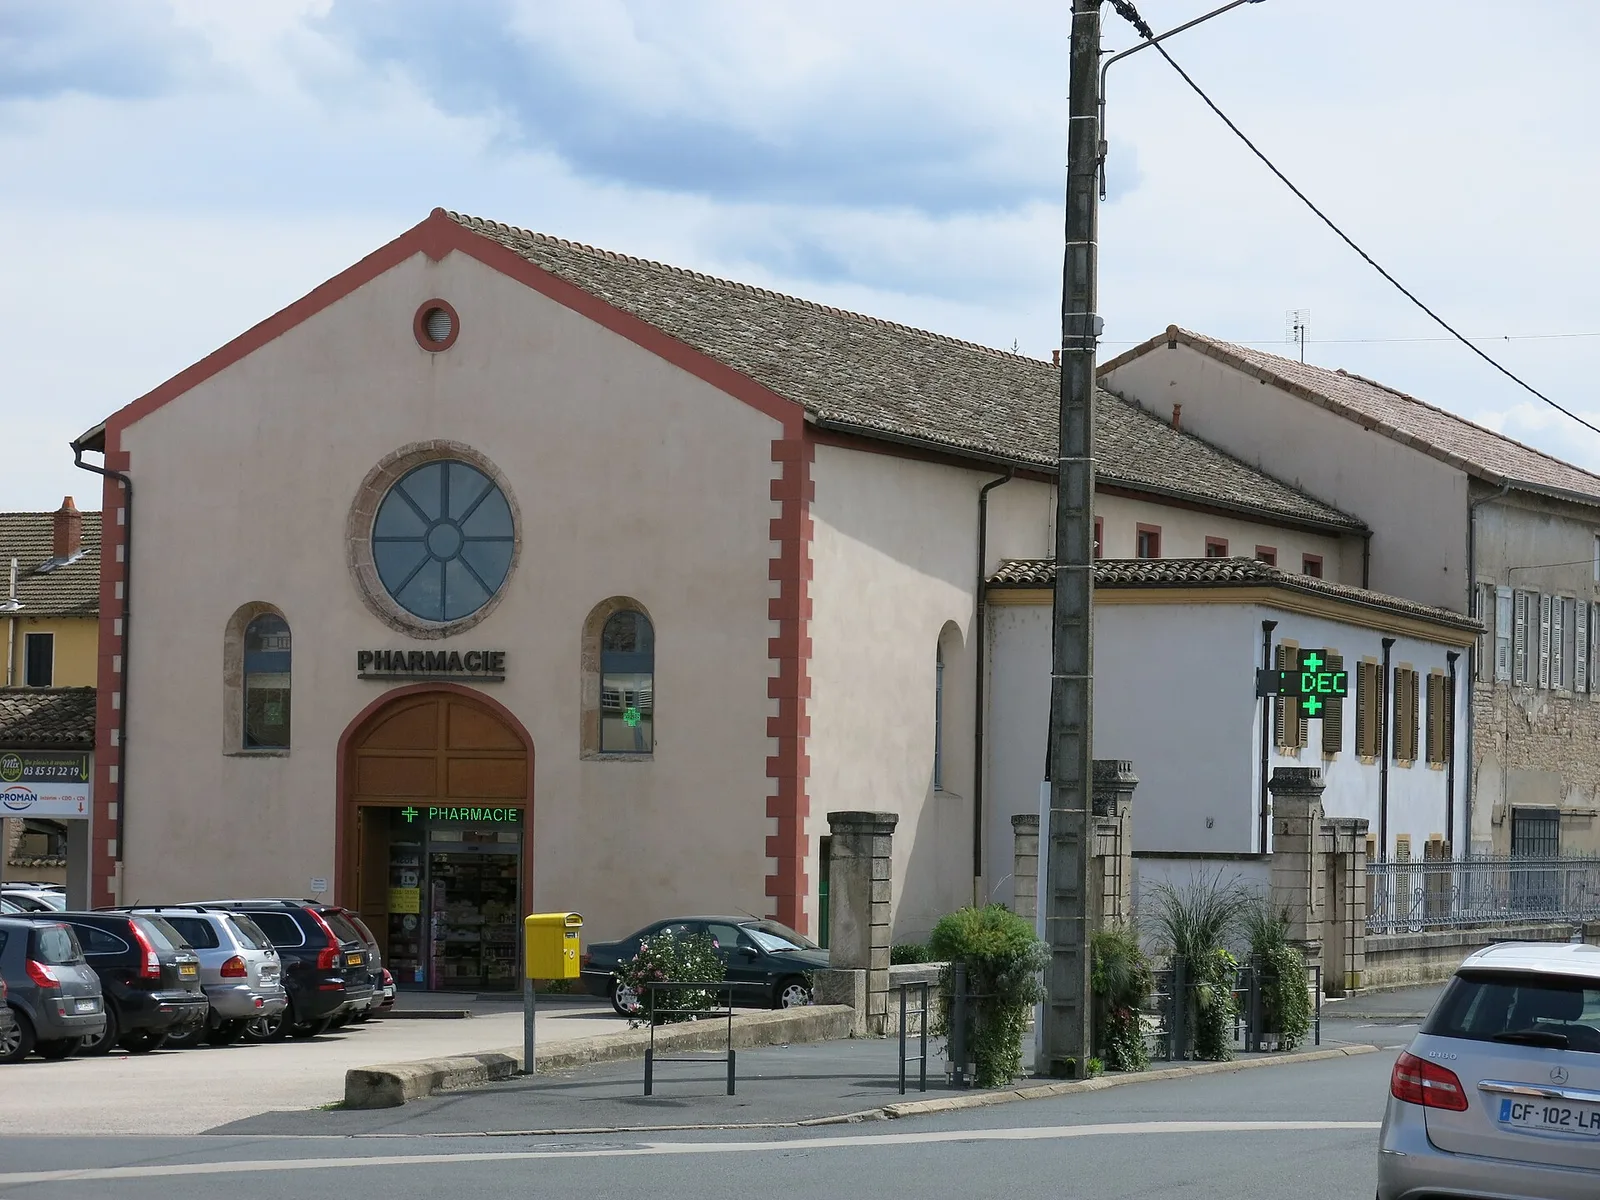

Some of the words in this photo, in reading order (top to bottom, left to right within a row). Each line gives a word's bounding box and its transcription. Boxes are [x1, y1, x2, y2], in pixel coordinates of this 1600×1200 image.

[357, 650, 505, 672] PHARMACIE
[1301, 672, 1345, 693] DEC
[23, 766, 33, 776] 03
[35, 766, 45, 776] 85
[46, 766, 55, 776] 51
[57, 766, 67, 776] 22
[70, 766, 79, 776] 19
[429, 807, 518, 822] PHARMACIE
